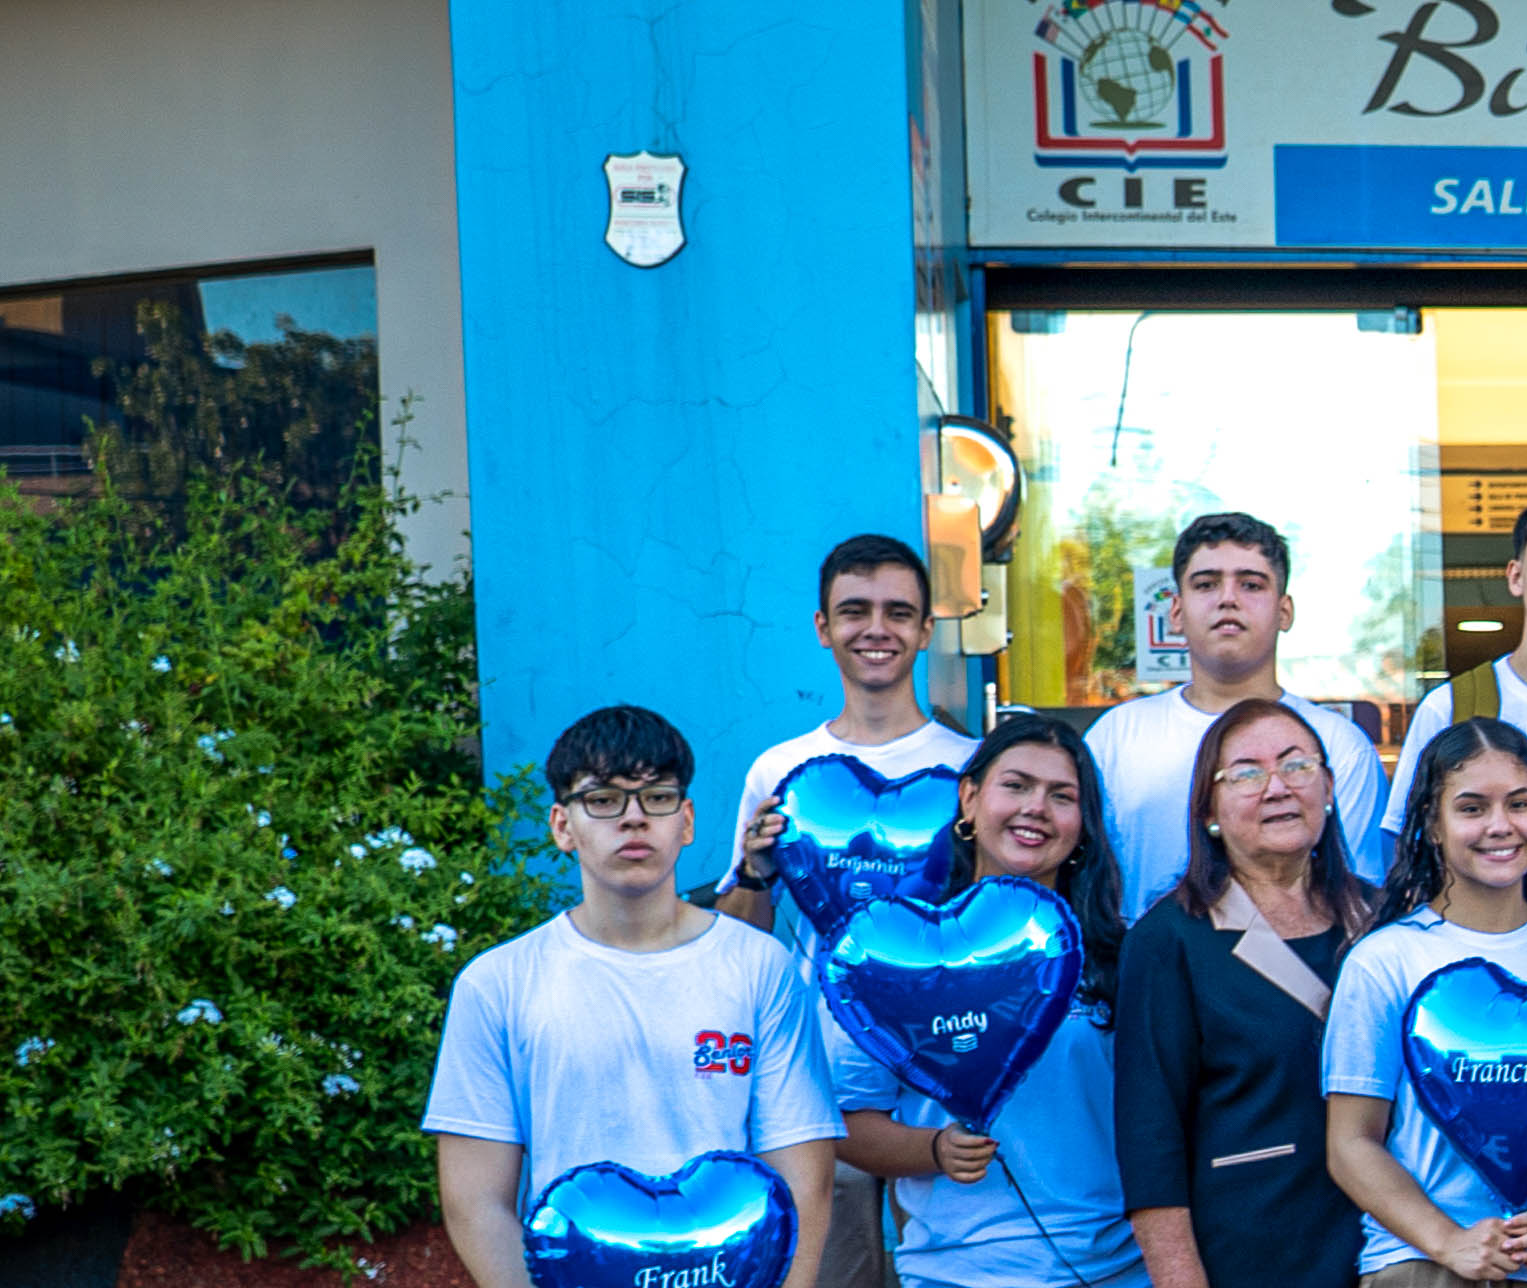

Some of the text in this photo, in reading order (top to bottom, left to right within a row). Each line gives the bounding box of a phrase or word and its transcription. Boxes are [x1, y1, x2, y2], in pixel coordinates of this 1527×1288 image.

[1058, 177, 1207, 208] CIE
[1026, 209, 1078, 225] Colegio
[1187, 209, 1207, 223] del
[1157, 655, 1189, 667] CI
[826, 852, 907, 875] Benjamin
[932, 1011, 988, 1036] Andy
